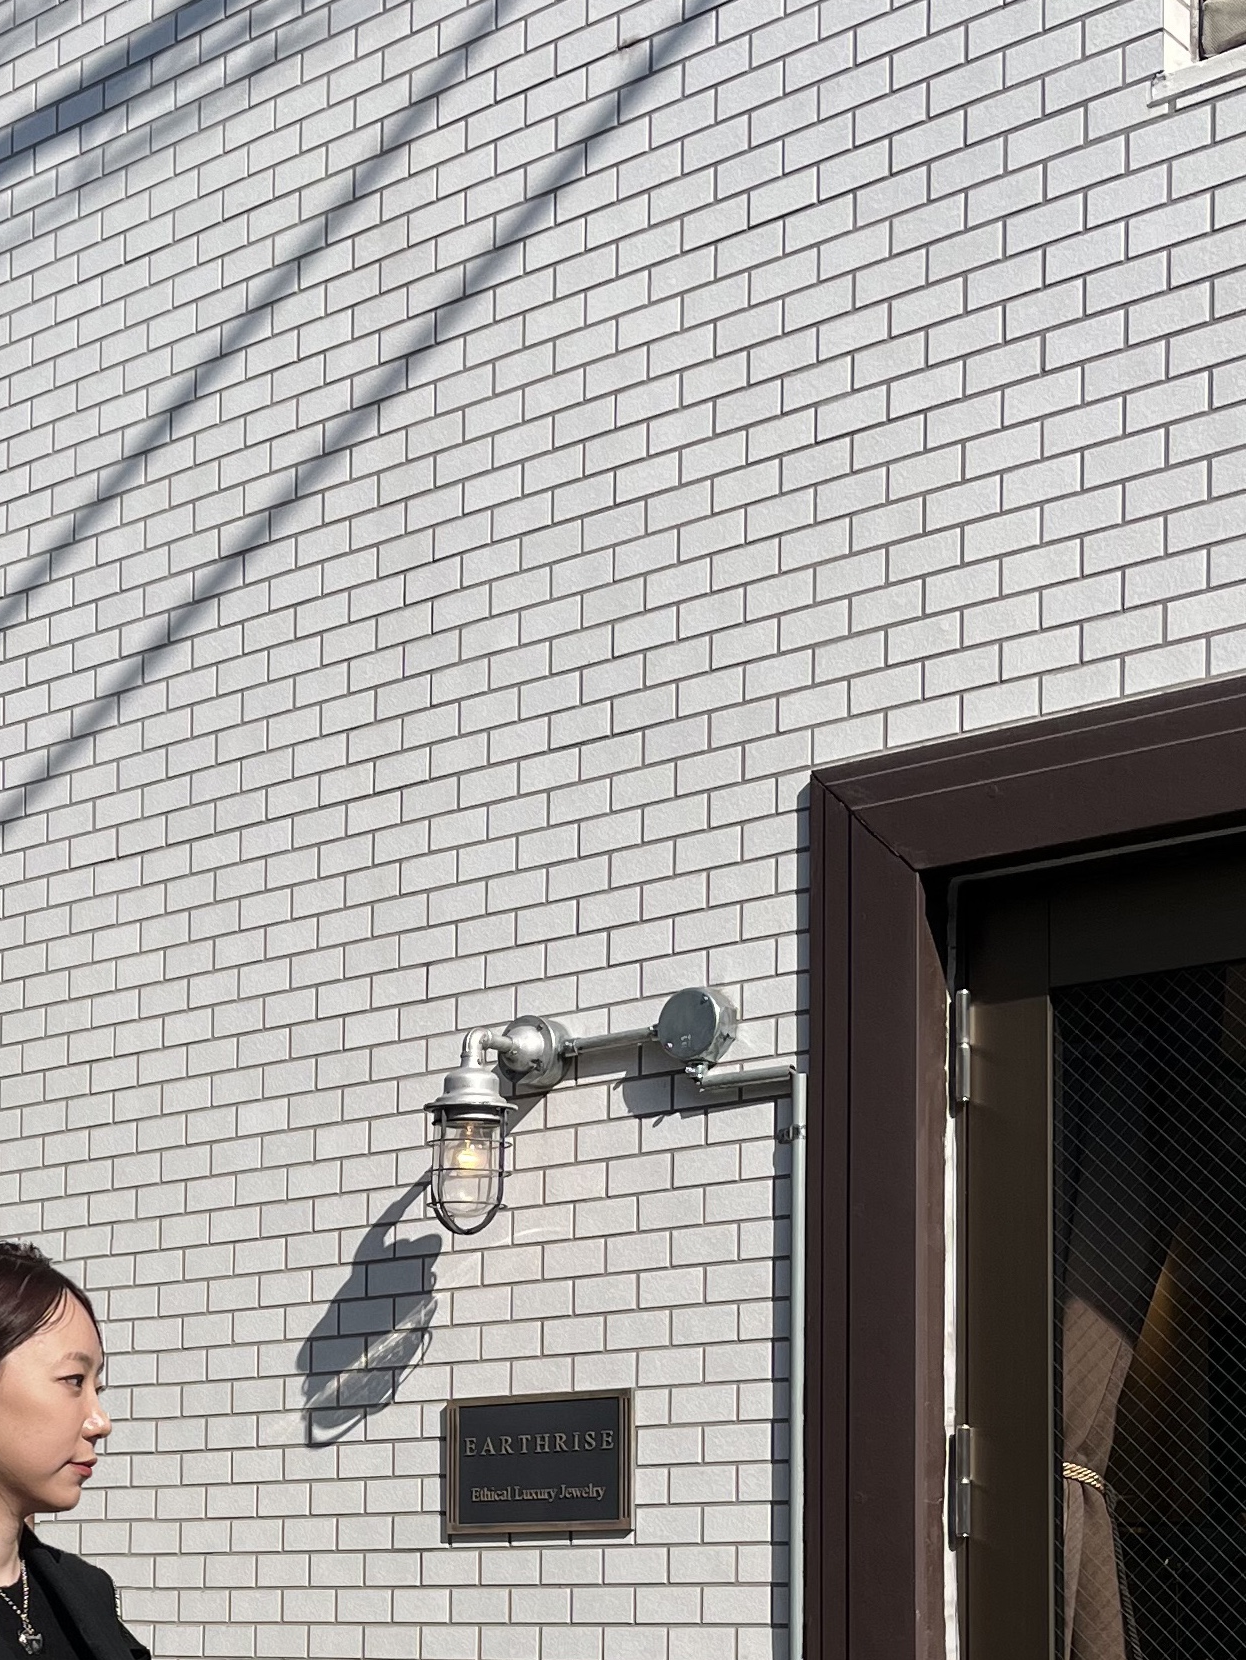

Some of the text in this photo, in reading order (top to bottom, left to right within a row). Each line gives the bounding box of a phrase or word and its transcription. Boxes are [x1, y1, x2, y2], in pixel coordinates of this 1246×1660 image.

[464, 1430, 615, 1456] EARTHRISE
[471, 1483, 606, 1502] Ethical Luxury Jewelry
